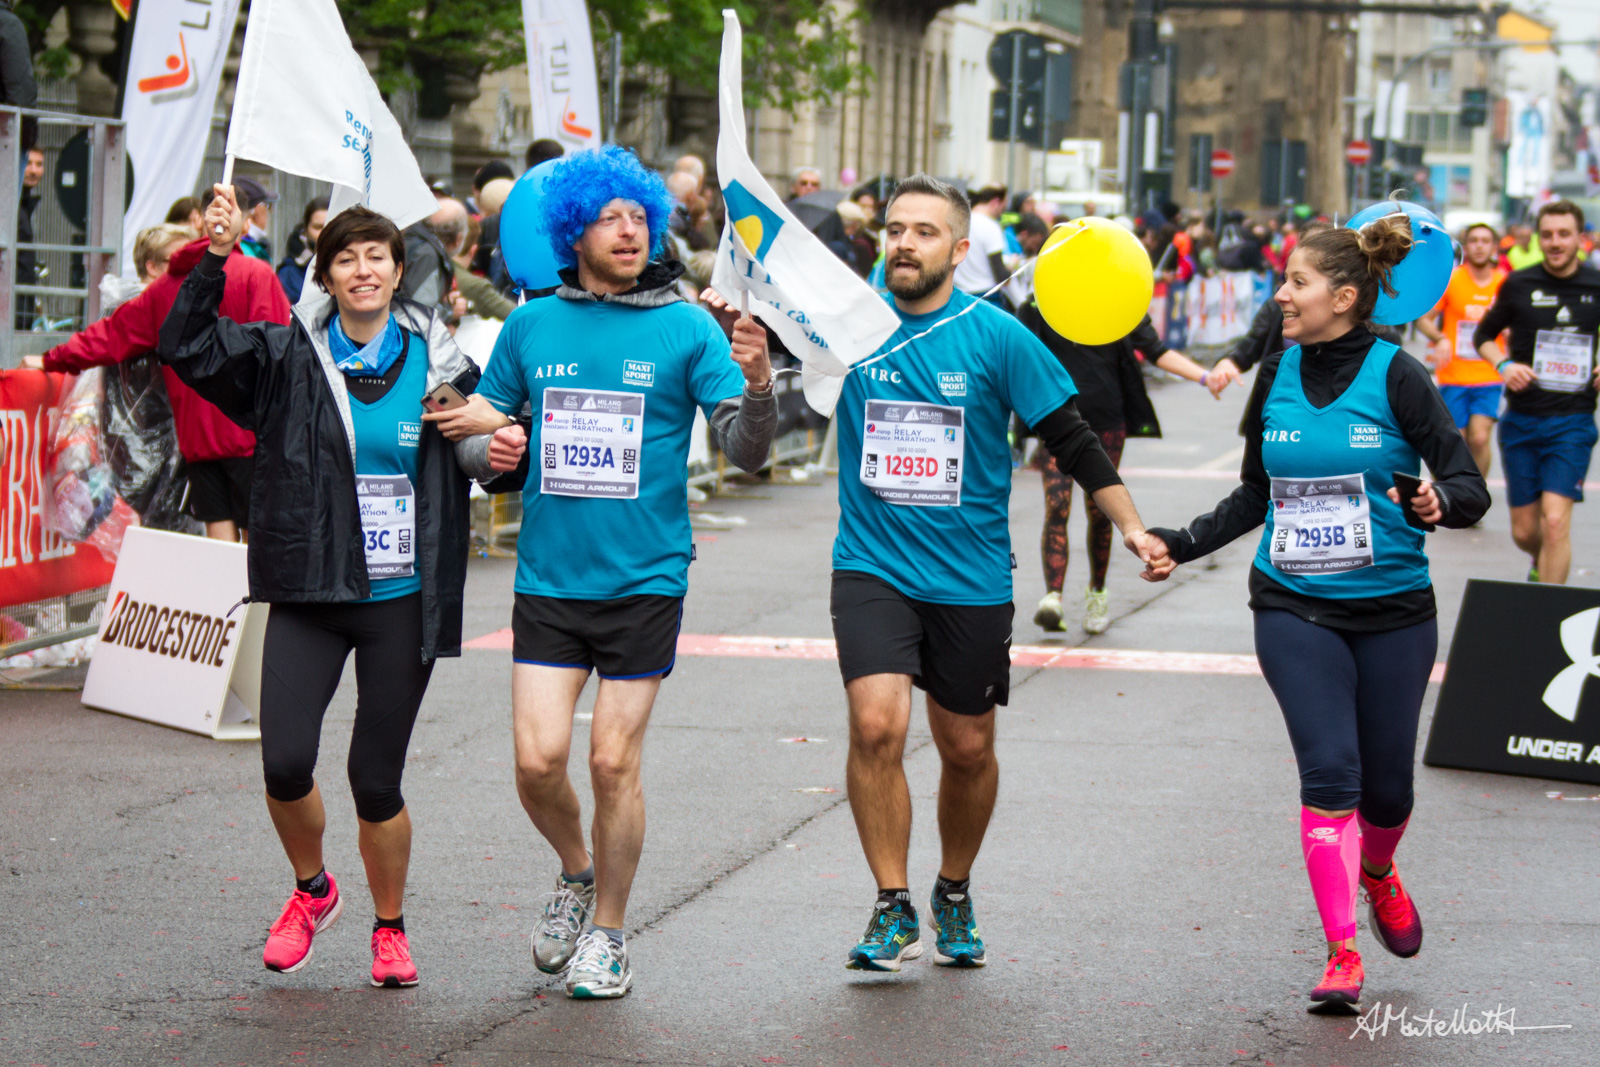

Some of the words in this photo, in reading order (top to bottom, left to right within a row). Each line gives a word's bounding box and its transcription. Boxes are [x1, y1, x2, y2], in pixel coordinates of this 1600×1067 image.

[551, 38, 570, 93] LILT
[534, 363, 579, 379] AIRC
[628, 363, 651, 373] MAXI
[625, 371, 652, 381] SPORT
[941, 375, 963, 383] MAXI
[359, 378, 386, 386] KIPSTA
[940, 382, 965, 391] SPORT
[597, 399, 622, 407] MILANO
[920, 410, 944, 418] MILANO
[572, 417, 599, 426] RELAY
[571, 424, 614, 433] MARATHON
[894, 428, 922, 437] RELAY
[400, 432, 419, 441] SPOR
[1351, 434, 1380, 442] SPORT
[562, 444, 615, 469] 1293A
[885, 454, 939, 478] 1293D
[558, 481, 586, 491] UNDER
[587, 483, 628, 493] ARMOUR
[880, 490, 910, 499] UNDER
[911, 492, 951, 501] ARMOUR
[1300, 500, 1327, 509] RELAY
[364, 530, 391, 551] 3C
[1295, 525, 1346, 548] 1293B
[1292, 561, 1322, 570] UNDER
[1323, 559, 1364, 569] ARMOUR
[101, 591, 236, 668] BRIDGESTONE
[1507, 735, 1583, 762] UNDER
[1585, 745, 1600, 765] A
